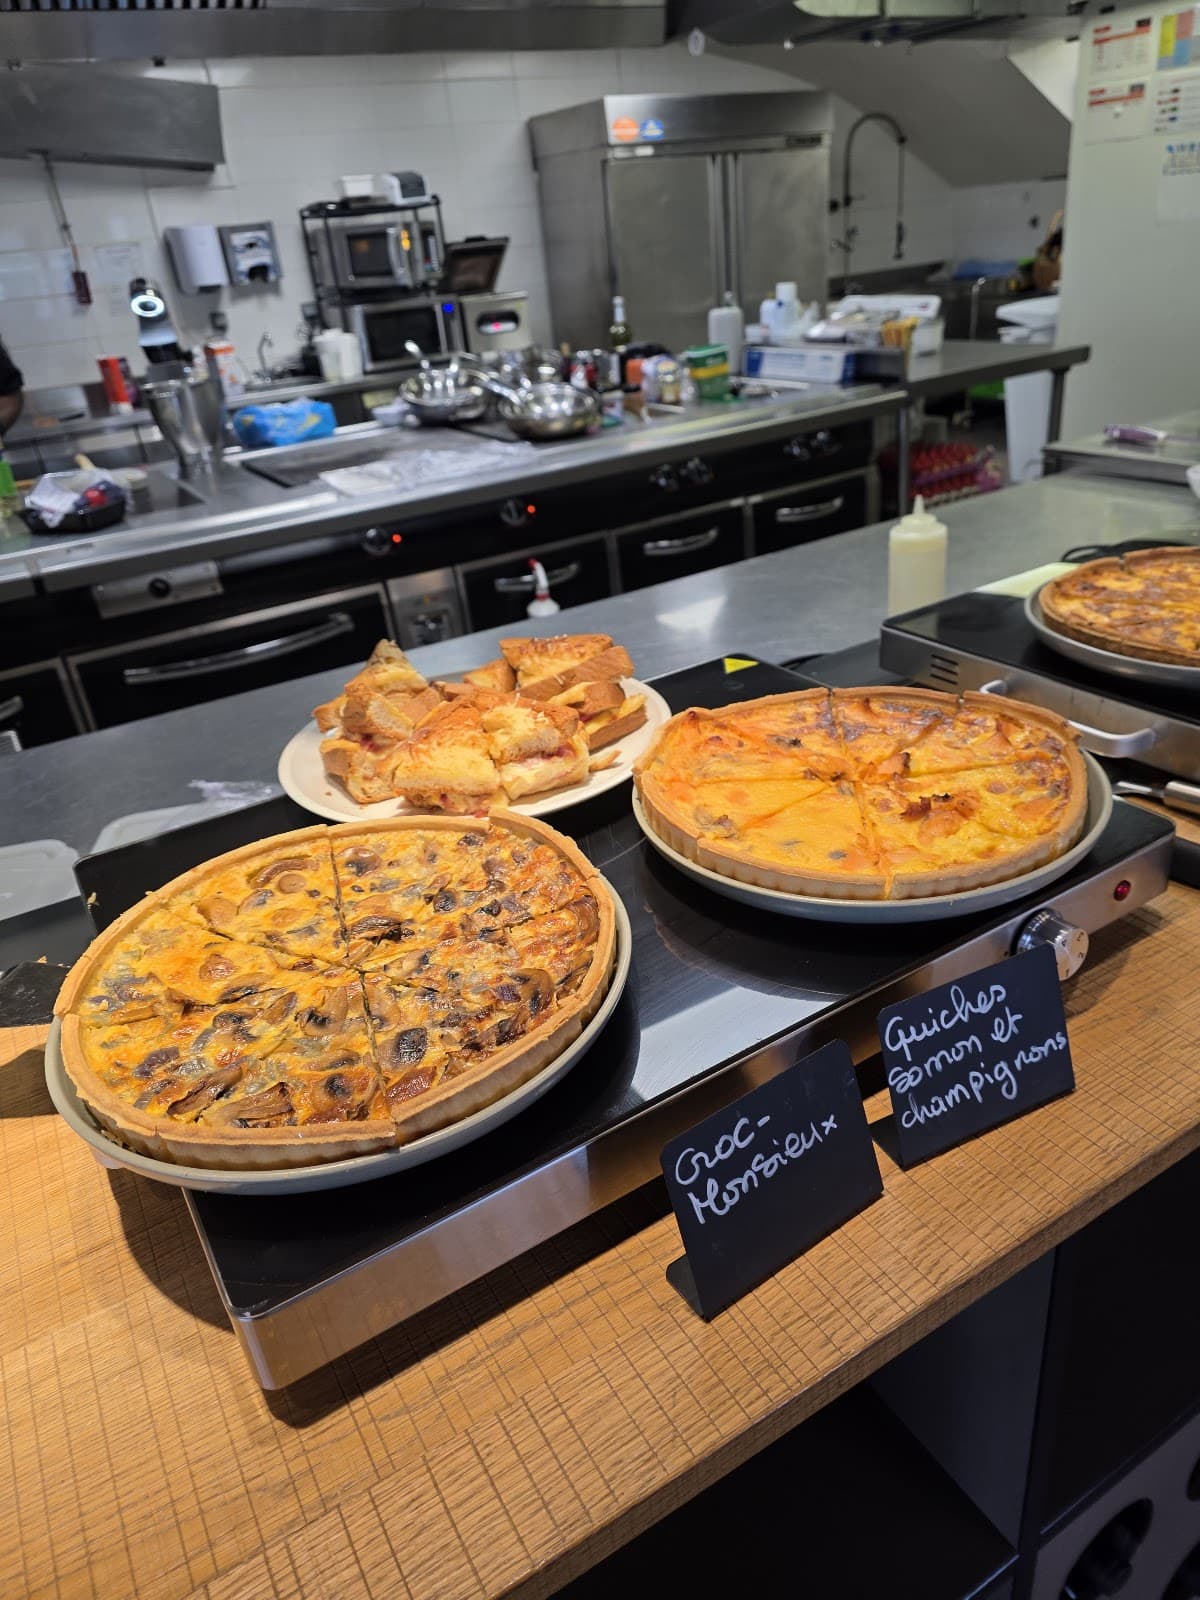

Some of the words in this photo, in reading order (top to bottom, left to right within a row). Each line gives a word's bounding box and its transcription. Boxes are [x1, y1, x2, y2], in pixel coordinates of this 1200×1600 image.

[884, 984, 1007, 1061] Quiches
[990, 1005, 1023, 1043] et
[901, 1031, 1067, 1129] champignons
